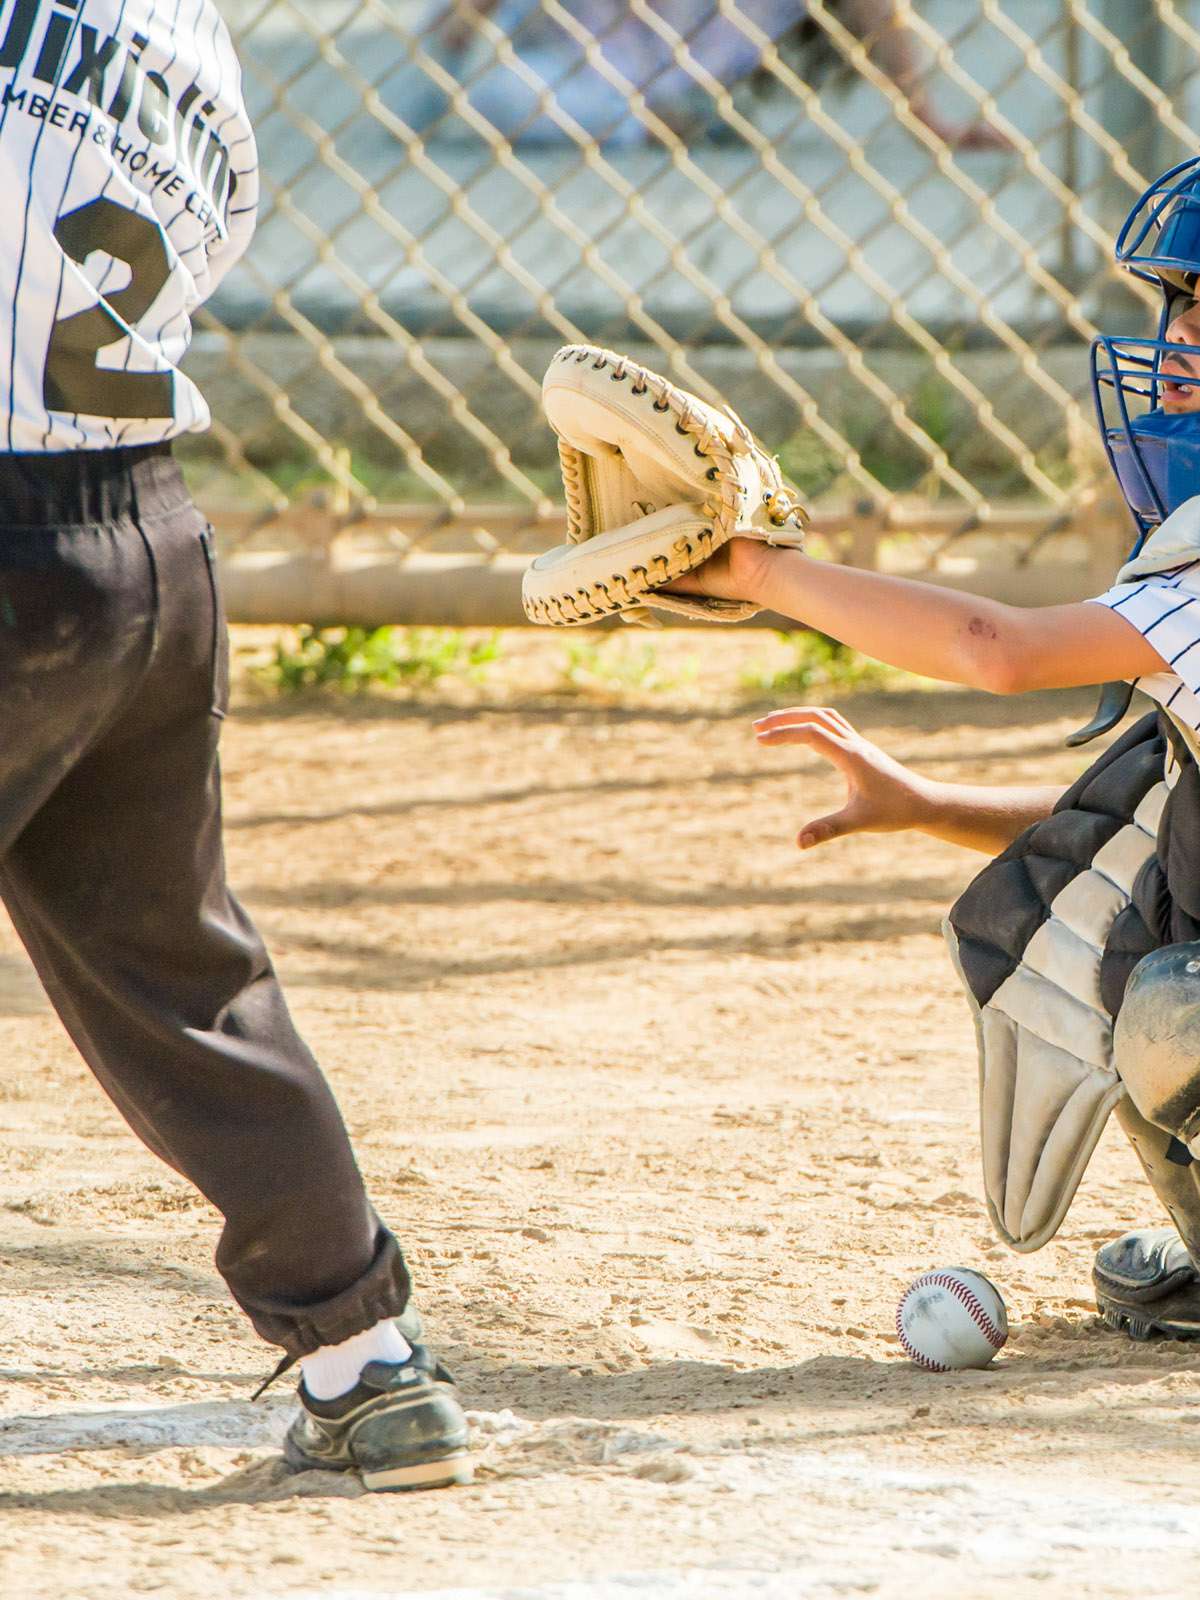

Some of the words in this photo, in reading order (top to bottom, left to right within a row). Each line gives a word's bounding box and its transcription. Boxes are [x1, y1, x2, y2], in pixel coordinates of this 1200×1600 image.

[92, 124, 107, 146] &
[111, 136, 185, 197] HOME
[43, 194, 175, 419] 2
